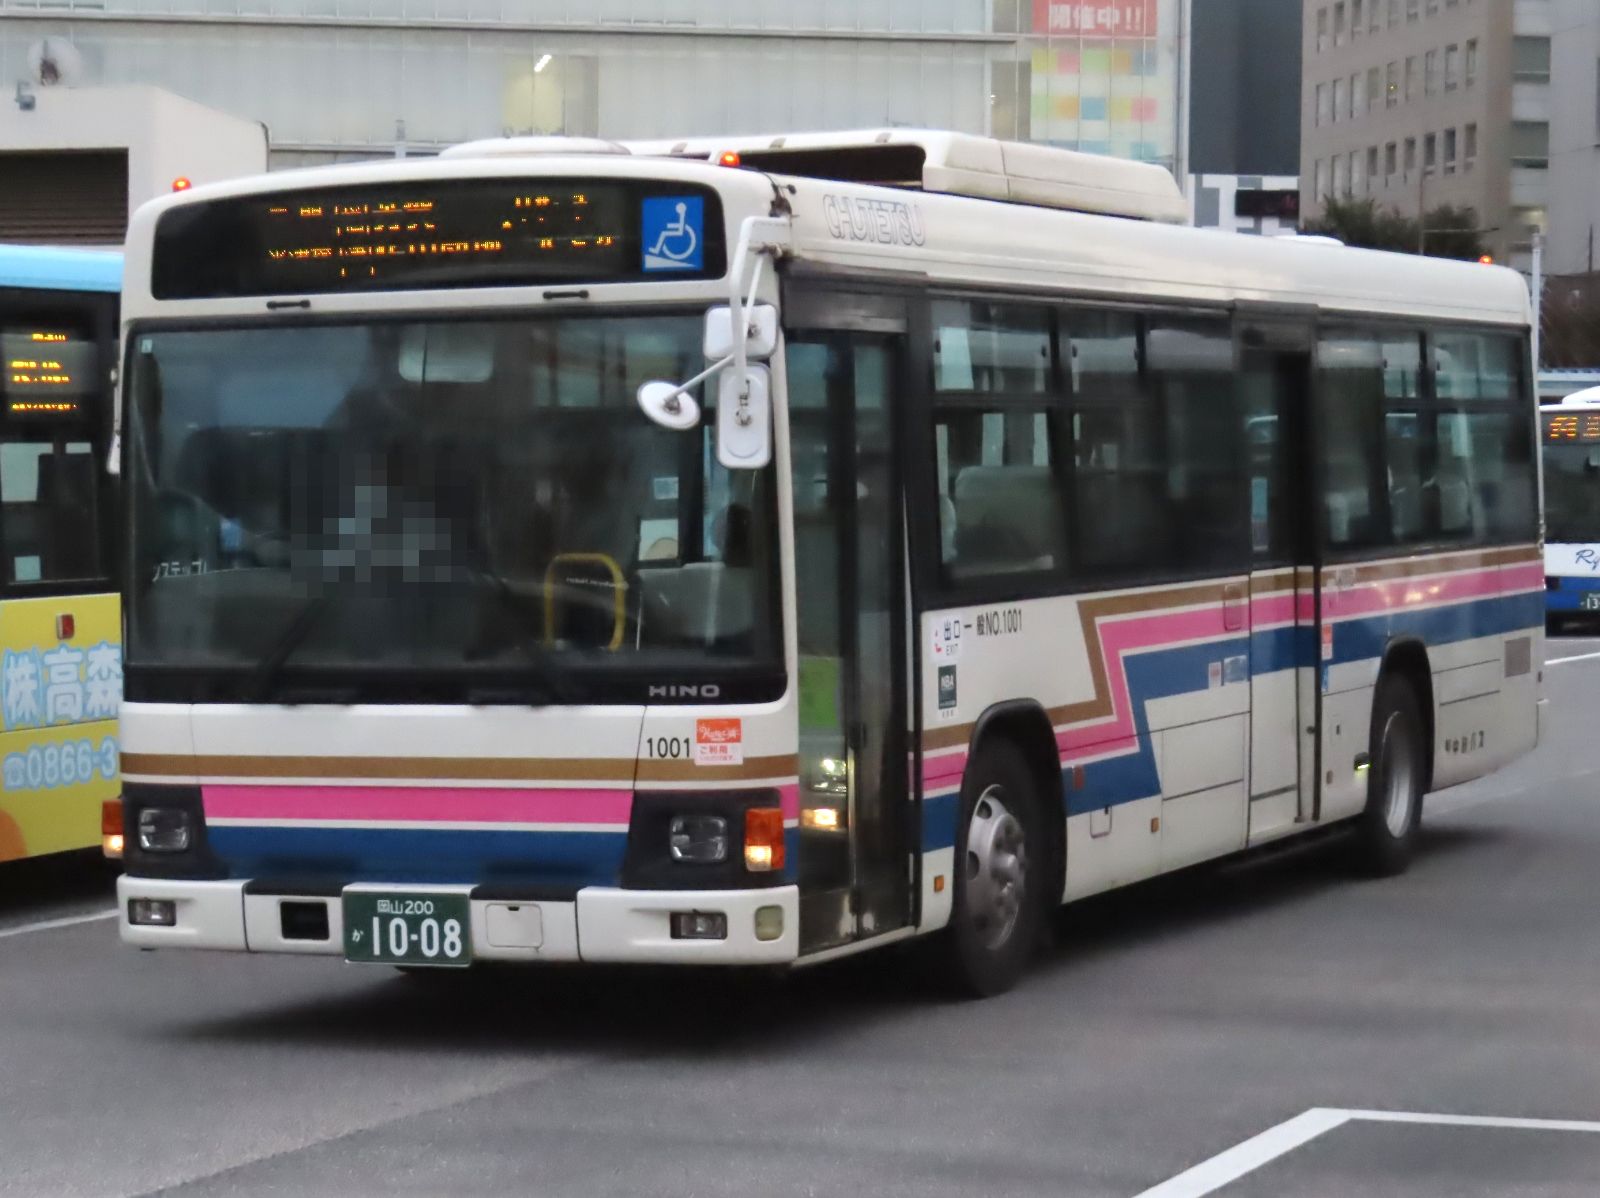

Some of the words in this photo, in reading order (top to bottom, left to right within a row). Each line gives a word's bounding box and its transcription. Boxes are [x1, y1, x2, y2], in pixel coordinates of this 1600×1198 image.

[823, 194, 926, 247] CHUTETSU
[943, 618, 960, 641] 出口
[648, 684, 720, 698] HINO
[646, 736, 691, 758] 1001
[372, 916, 463, 958] 10-08
